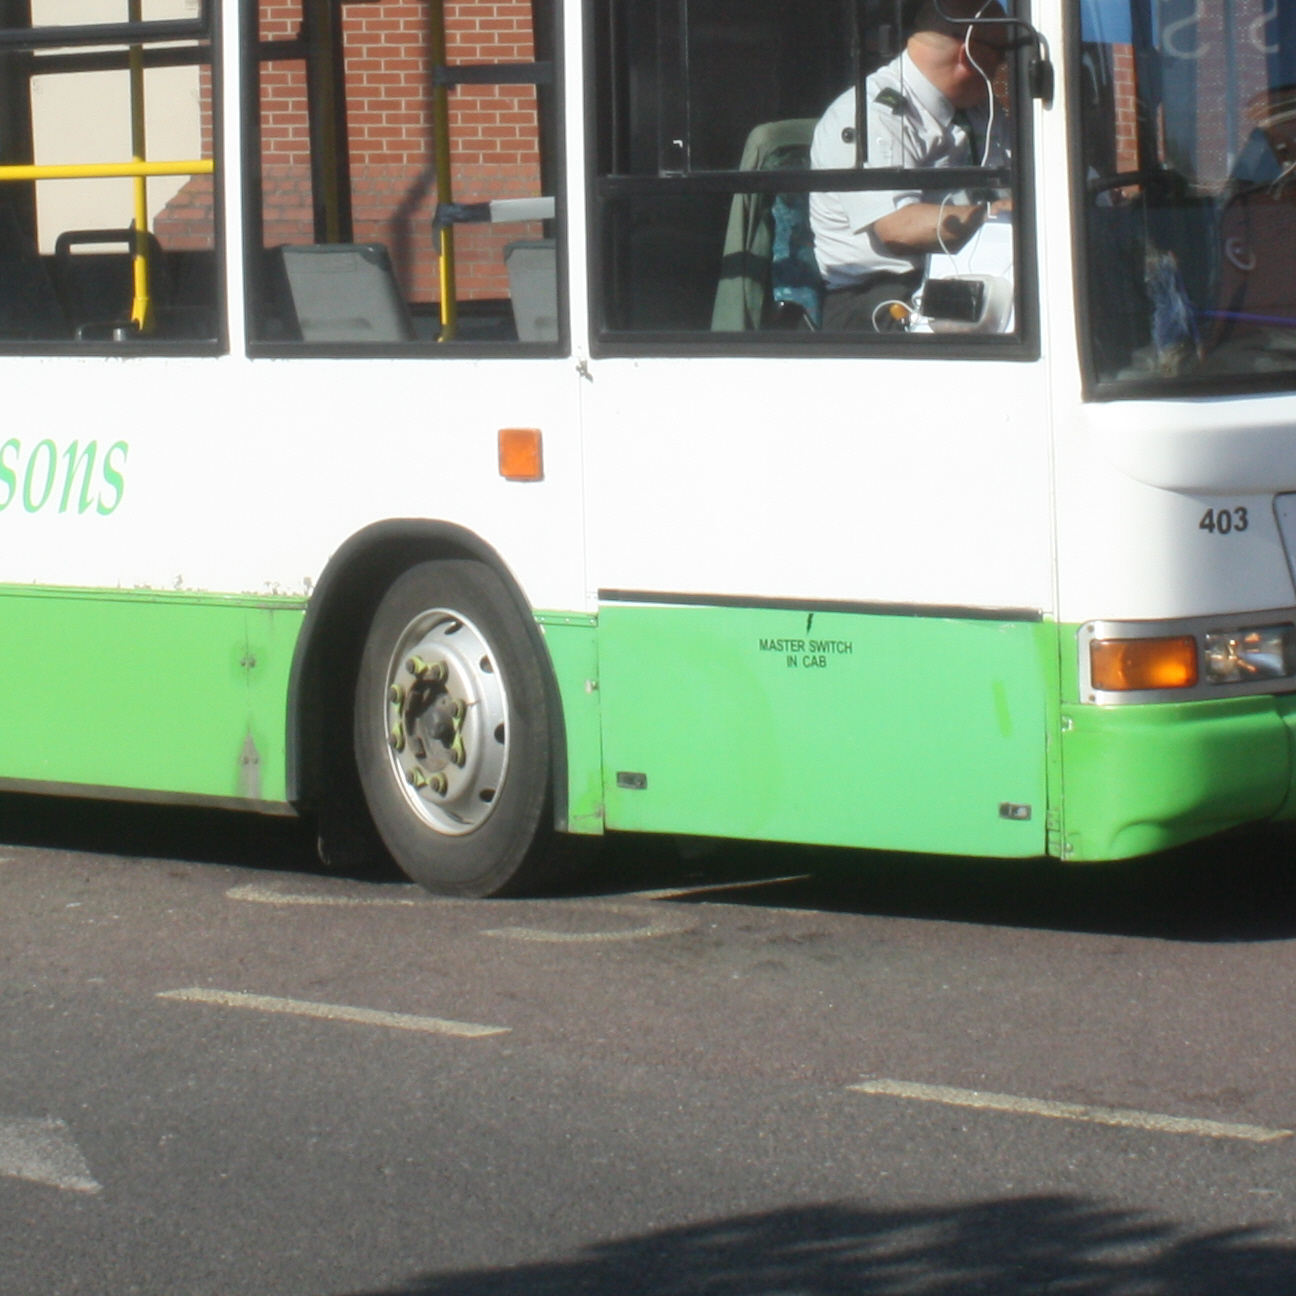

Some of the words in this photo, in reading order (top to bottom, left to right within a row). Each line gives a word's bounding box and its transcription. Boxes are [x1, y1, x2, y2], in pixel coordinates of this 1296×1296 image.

[1199, 506, 1248, 535] 403
[759, 639, 805, 652] MASTER
[809, 640, 853, 654] SWITCH
[787, 655, 797, 667] IN
[802, 655, 827, 668] CAB
